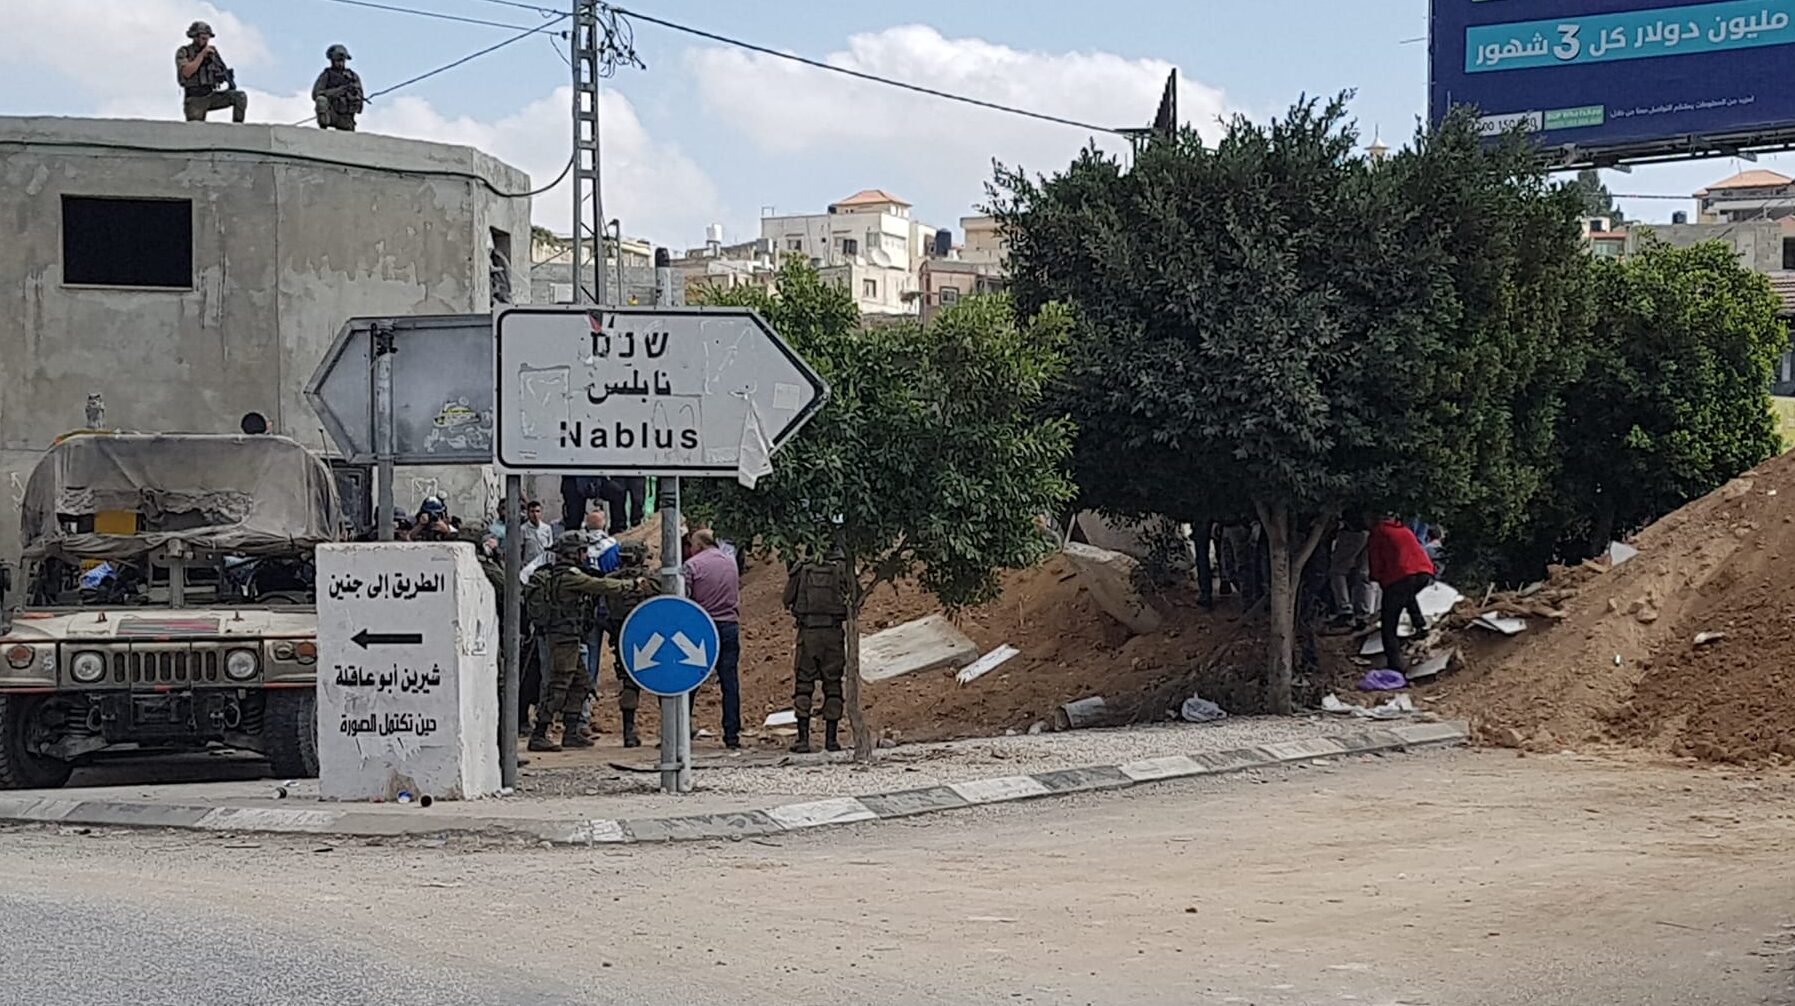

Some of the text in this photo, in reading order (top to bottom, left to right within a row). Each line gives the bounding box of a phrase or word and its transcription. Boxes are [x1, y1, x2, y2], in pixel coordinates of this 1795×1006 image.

[1475, 9, 1789, 66] مليون دولار كل 3 شهور
[588, 369, 671, 405] نابلس
[560, 421, 698, 449] Nablus
[329, 572, 445, 600] الطريق إلى جنين
[334, 663, 440, 694] شيرين أبو عاقلة
[340, 713, 437, 737] حين تكتمل الصورة
